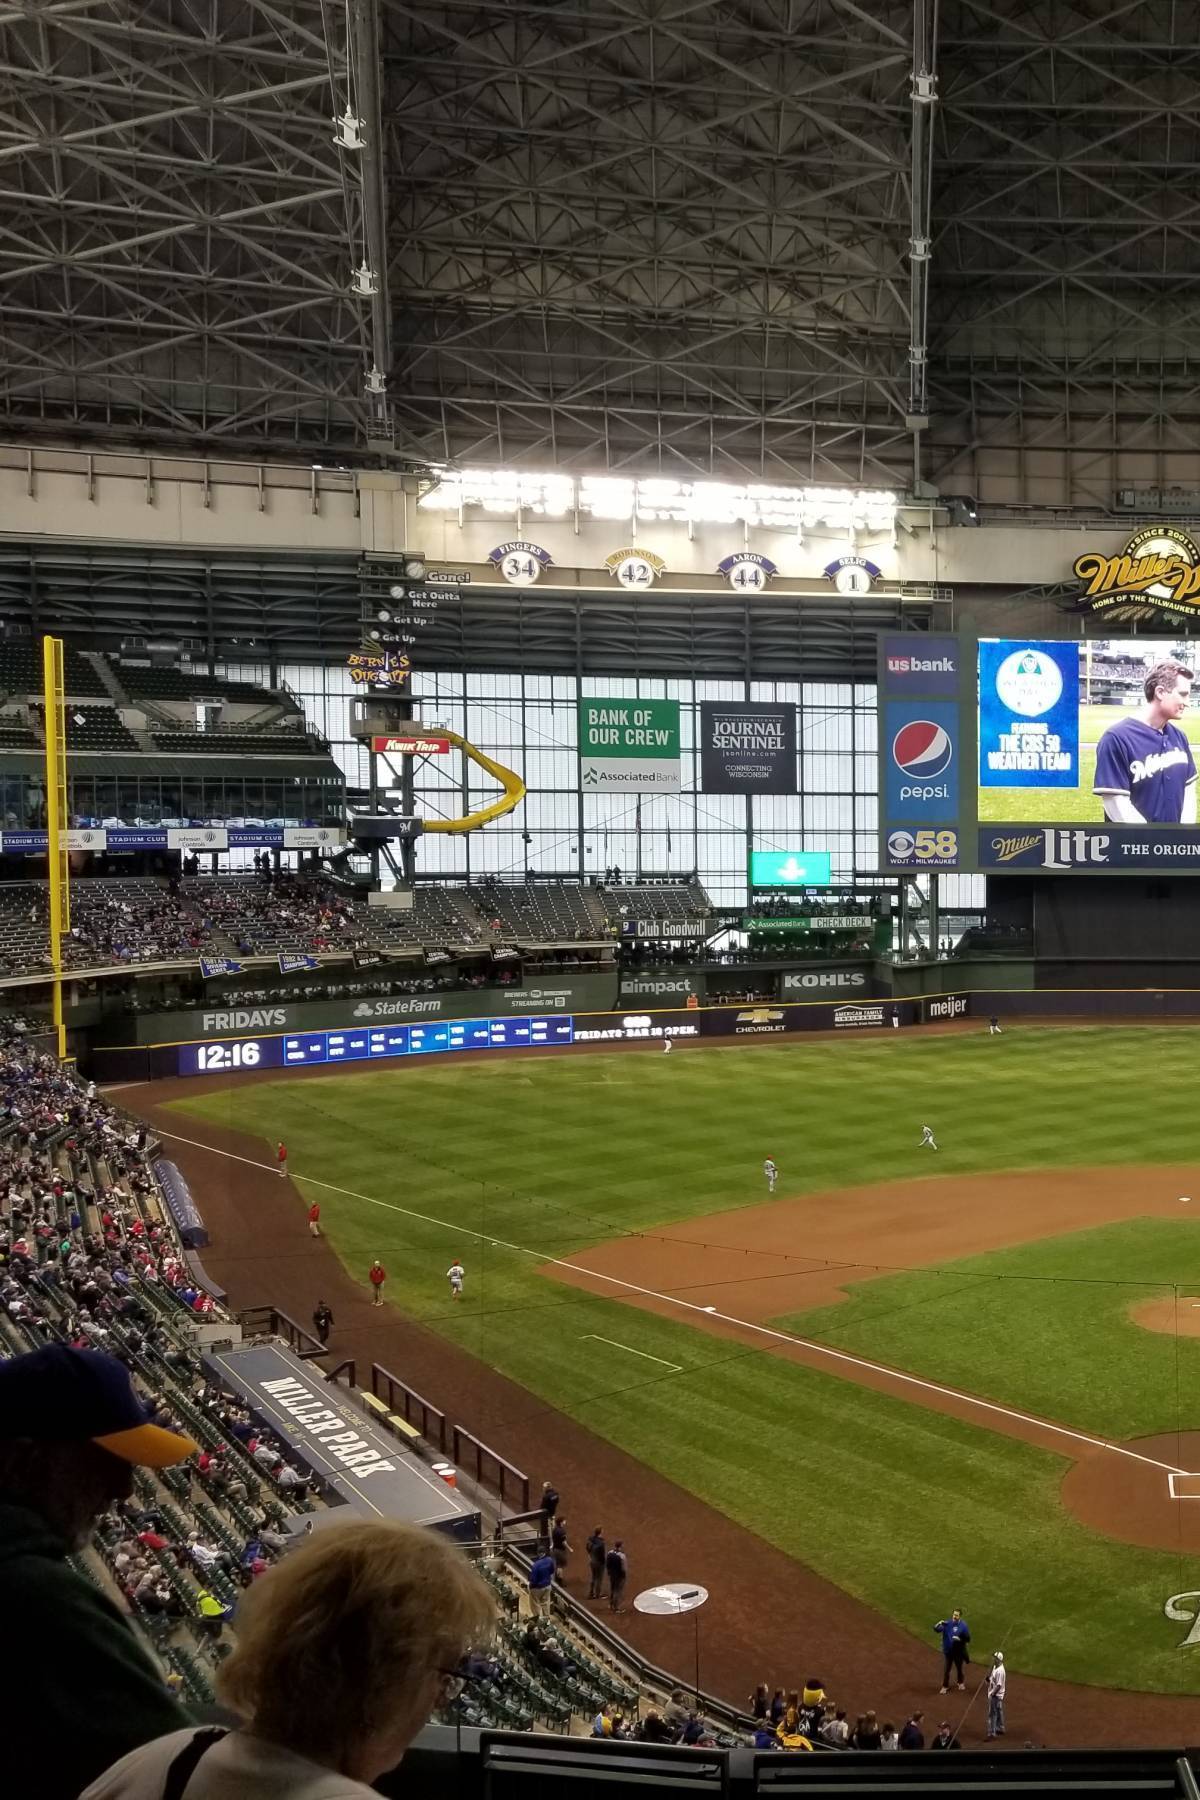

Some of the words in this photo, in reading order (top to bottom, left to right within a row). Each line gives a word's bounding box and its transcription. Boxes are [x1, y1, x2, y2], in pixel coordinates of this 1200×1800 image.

[1134, 528, 1165, 544] SINCE
[1168, 530, 1189, 546] 2001
[499, 541, 542, 557] FINGERS
[613, 548, 658, 563] ROBINSON
[732, 553, 764, 564] AARON
[838, 556, 866, 567] SELIG
[506, 558, 536, 578] 34
[622, 564, 648, 583] 42
[1075, 552, 1182, 595] Miller
[428, 572, 470, 583] Gone!
[734, 568, 761, 587] 44
[848, 574, 860, 592] 1
[408, 591, 428, 600] Get
[431, 592, 460, 602] Outta
[412, 600, 438, 608] Here
[1092, 598, 1114, 610] HOME
[1130, 594, 1146, 602] THE
[1148, 597, 1196, 615] MILWAUKEE
[394, 616, 412, 624] Get
[412, 616, 428, 626] Up
[382, 634, 399, 642] Get
[400, 634, 416, 644] Up
[588, 708, 629, 726] BANK
[634, 710, 653, 726] OF
[588, 728, 622, 746] OUR
[712, 722, 786, 736] JOURNAL
[712, 736, 786, 750] SENTINEL
[988, 752, 1040, 770] WEATHER
[1042, 752, 1071, 770] TEAM
[900, 784, 947, 801] pepsi
[914, 831, 958, 858] 58
[992, 834, 1043, 861] Miller
[1041, 828, 1110, 868] Lite
[1121, 844, 1150, 855] THE
[638, 922, 659, 937] Club
[662, 919, 706, 936] Goodwill
[817, 918, 844, 928] CHECK
[846, 918, 866, 927] DECK
[634, 978, 691, 995] impact
[784, 972, 865, 988] KOHL'S
[930, 996, 966, 1018] meijer
[203, 1008, 287, 1031] FRIDAYS
[736, 1025, 786, 1034] CHEVROLET
[198, 1042, 260, 1069] 12:16
[259, 1376, 346, 1435] MILLER
[318, 1430, 396, 1479] PARK
